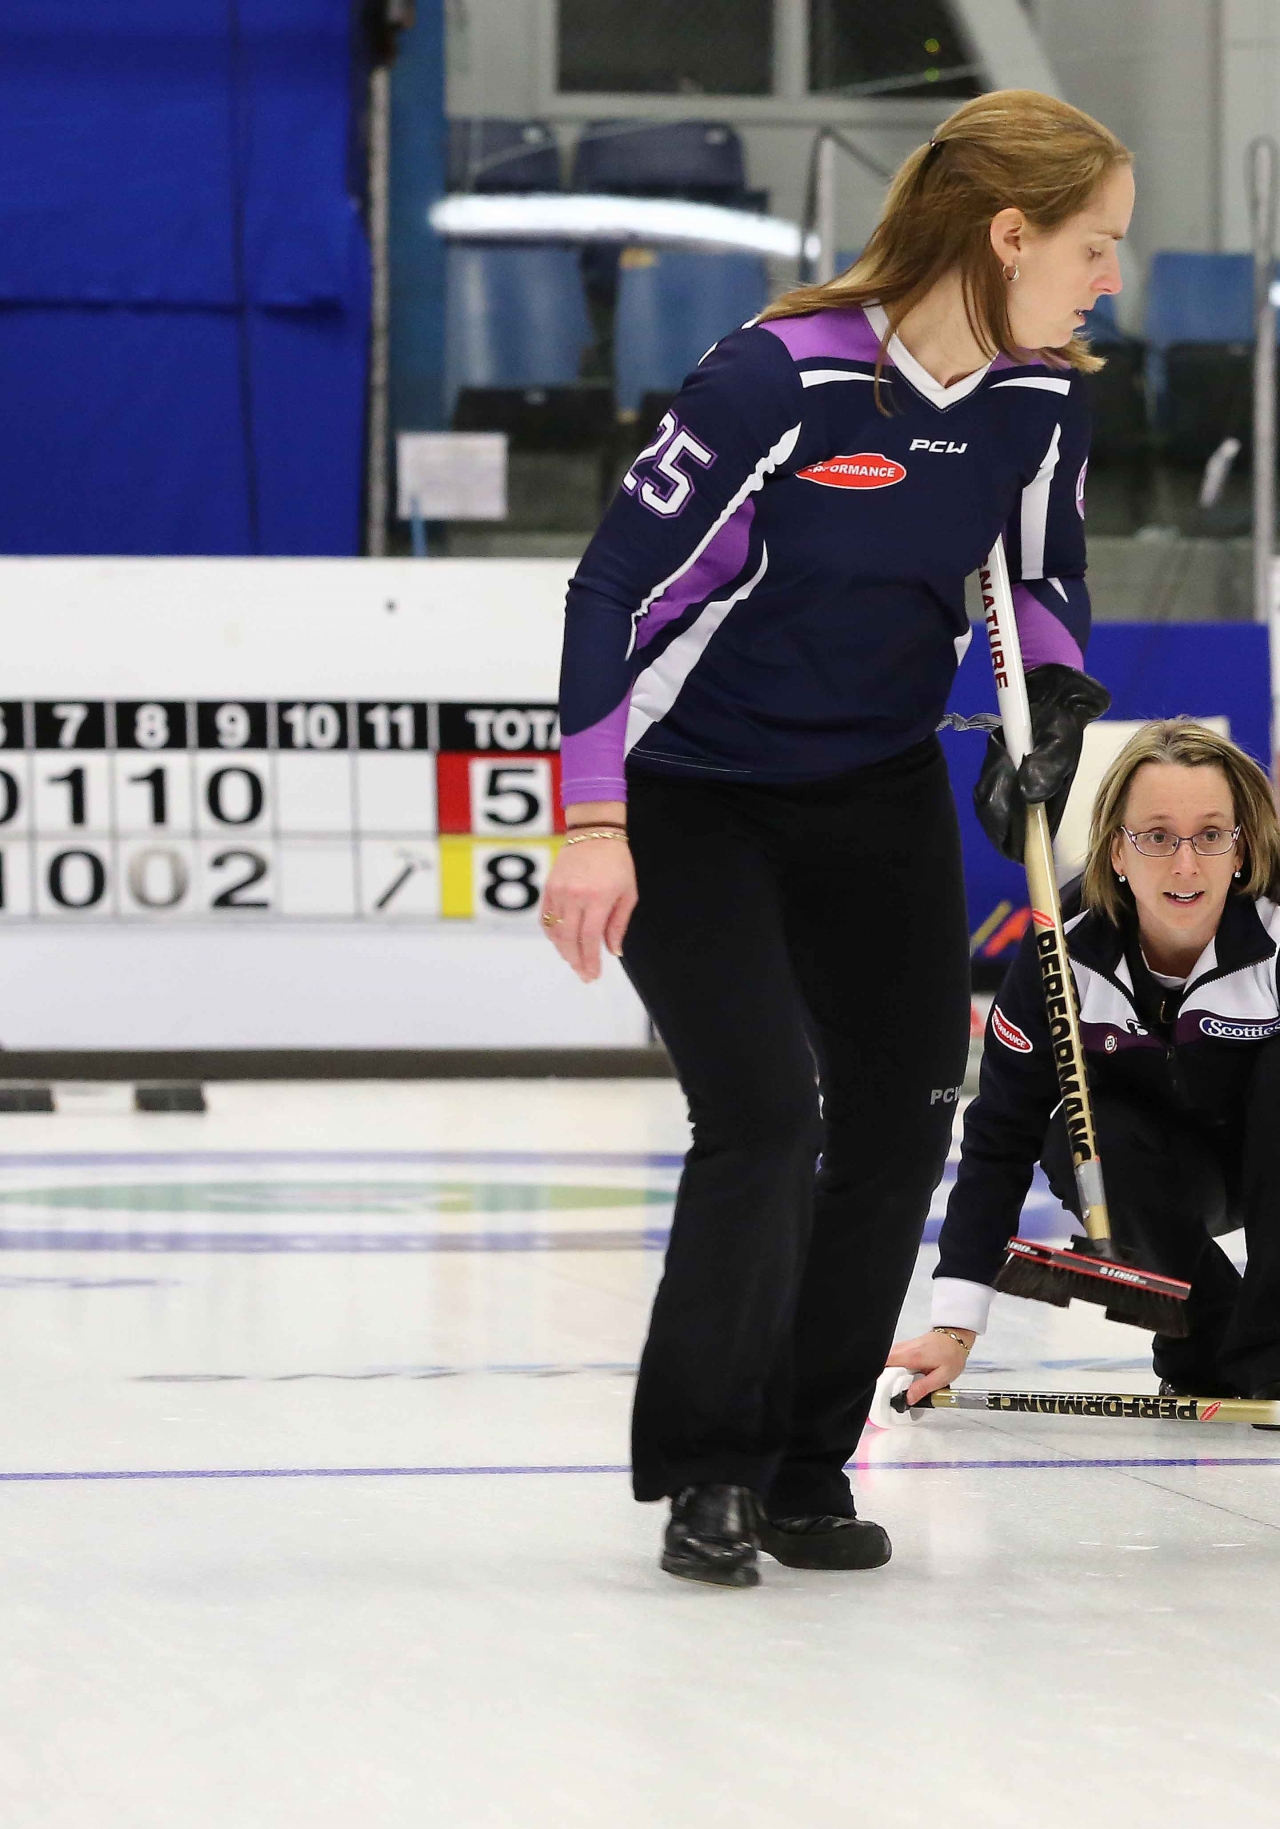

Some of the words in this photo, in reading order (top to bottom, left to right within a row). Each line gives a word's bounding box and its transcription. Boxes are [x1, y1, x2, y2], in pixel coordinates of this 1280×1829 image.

[622, 410, 715, 517] 25
[909, 438, 968, 454] PCW
[52, 703, 88, 749] 7
[134, 703, 170, 749] 8
[214, 703, 251, 749] 9
[283, 703, 341, 750] 10
[365, 703, 414, 750] 11
[49, 766, 86, 825] 1
[131, 766, 166, 825] 1
[206, 766, 264, 826] 0
[484, 767, 541, 826] 5
[47, 850, 105, 909] 0
[128, 850, 188, 908] 0
[211, 850, 270, 910] 2
[484, 853, 541, 912] 8
[986, 1392, 1199, 1421] PERFORMANCE
